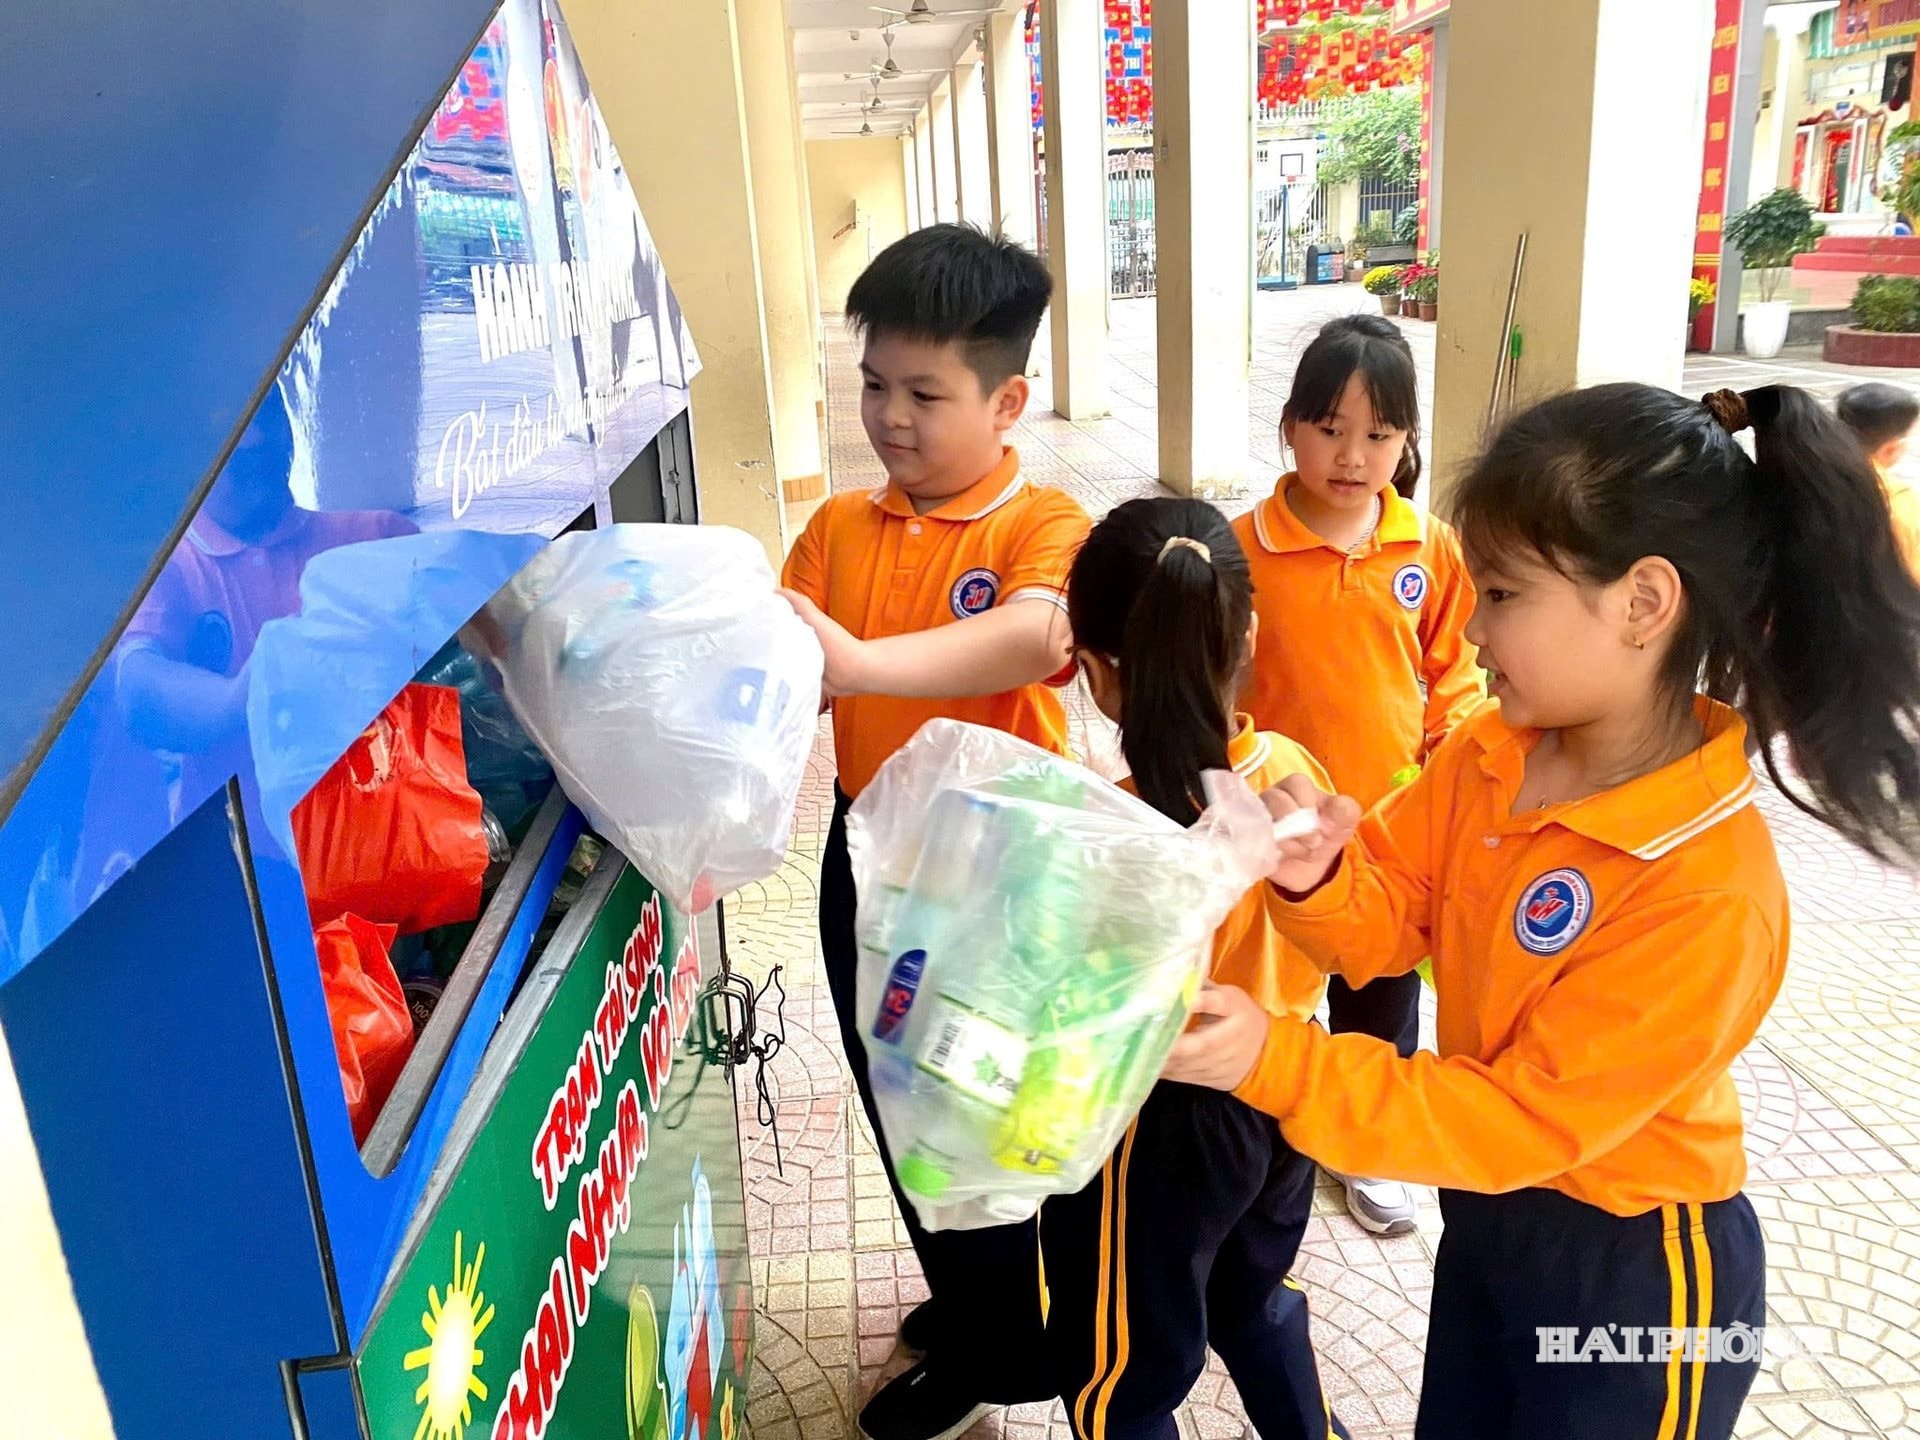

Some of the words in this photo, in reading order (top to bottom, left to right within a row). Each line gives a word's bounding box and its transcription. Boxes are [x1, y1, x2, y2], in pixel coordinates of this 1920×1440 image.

[533, 1032, 600, 1209] TRẠM
[595, 962, 627, 1074] TÁI
[624, 890, 662, 1021] SINH
